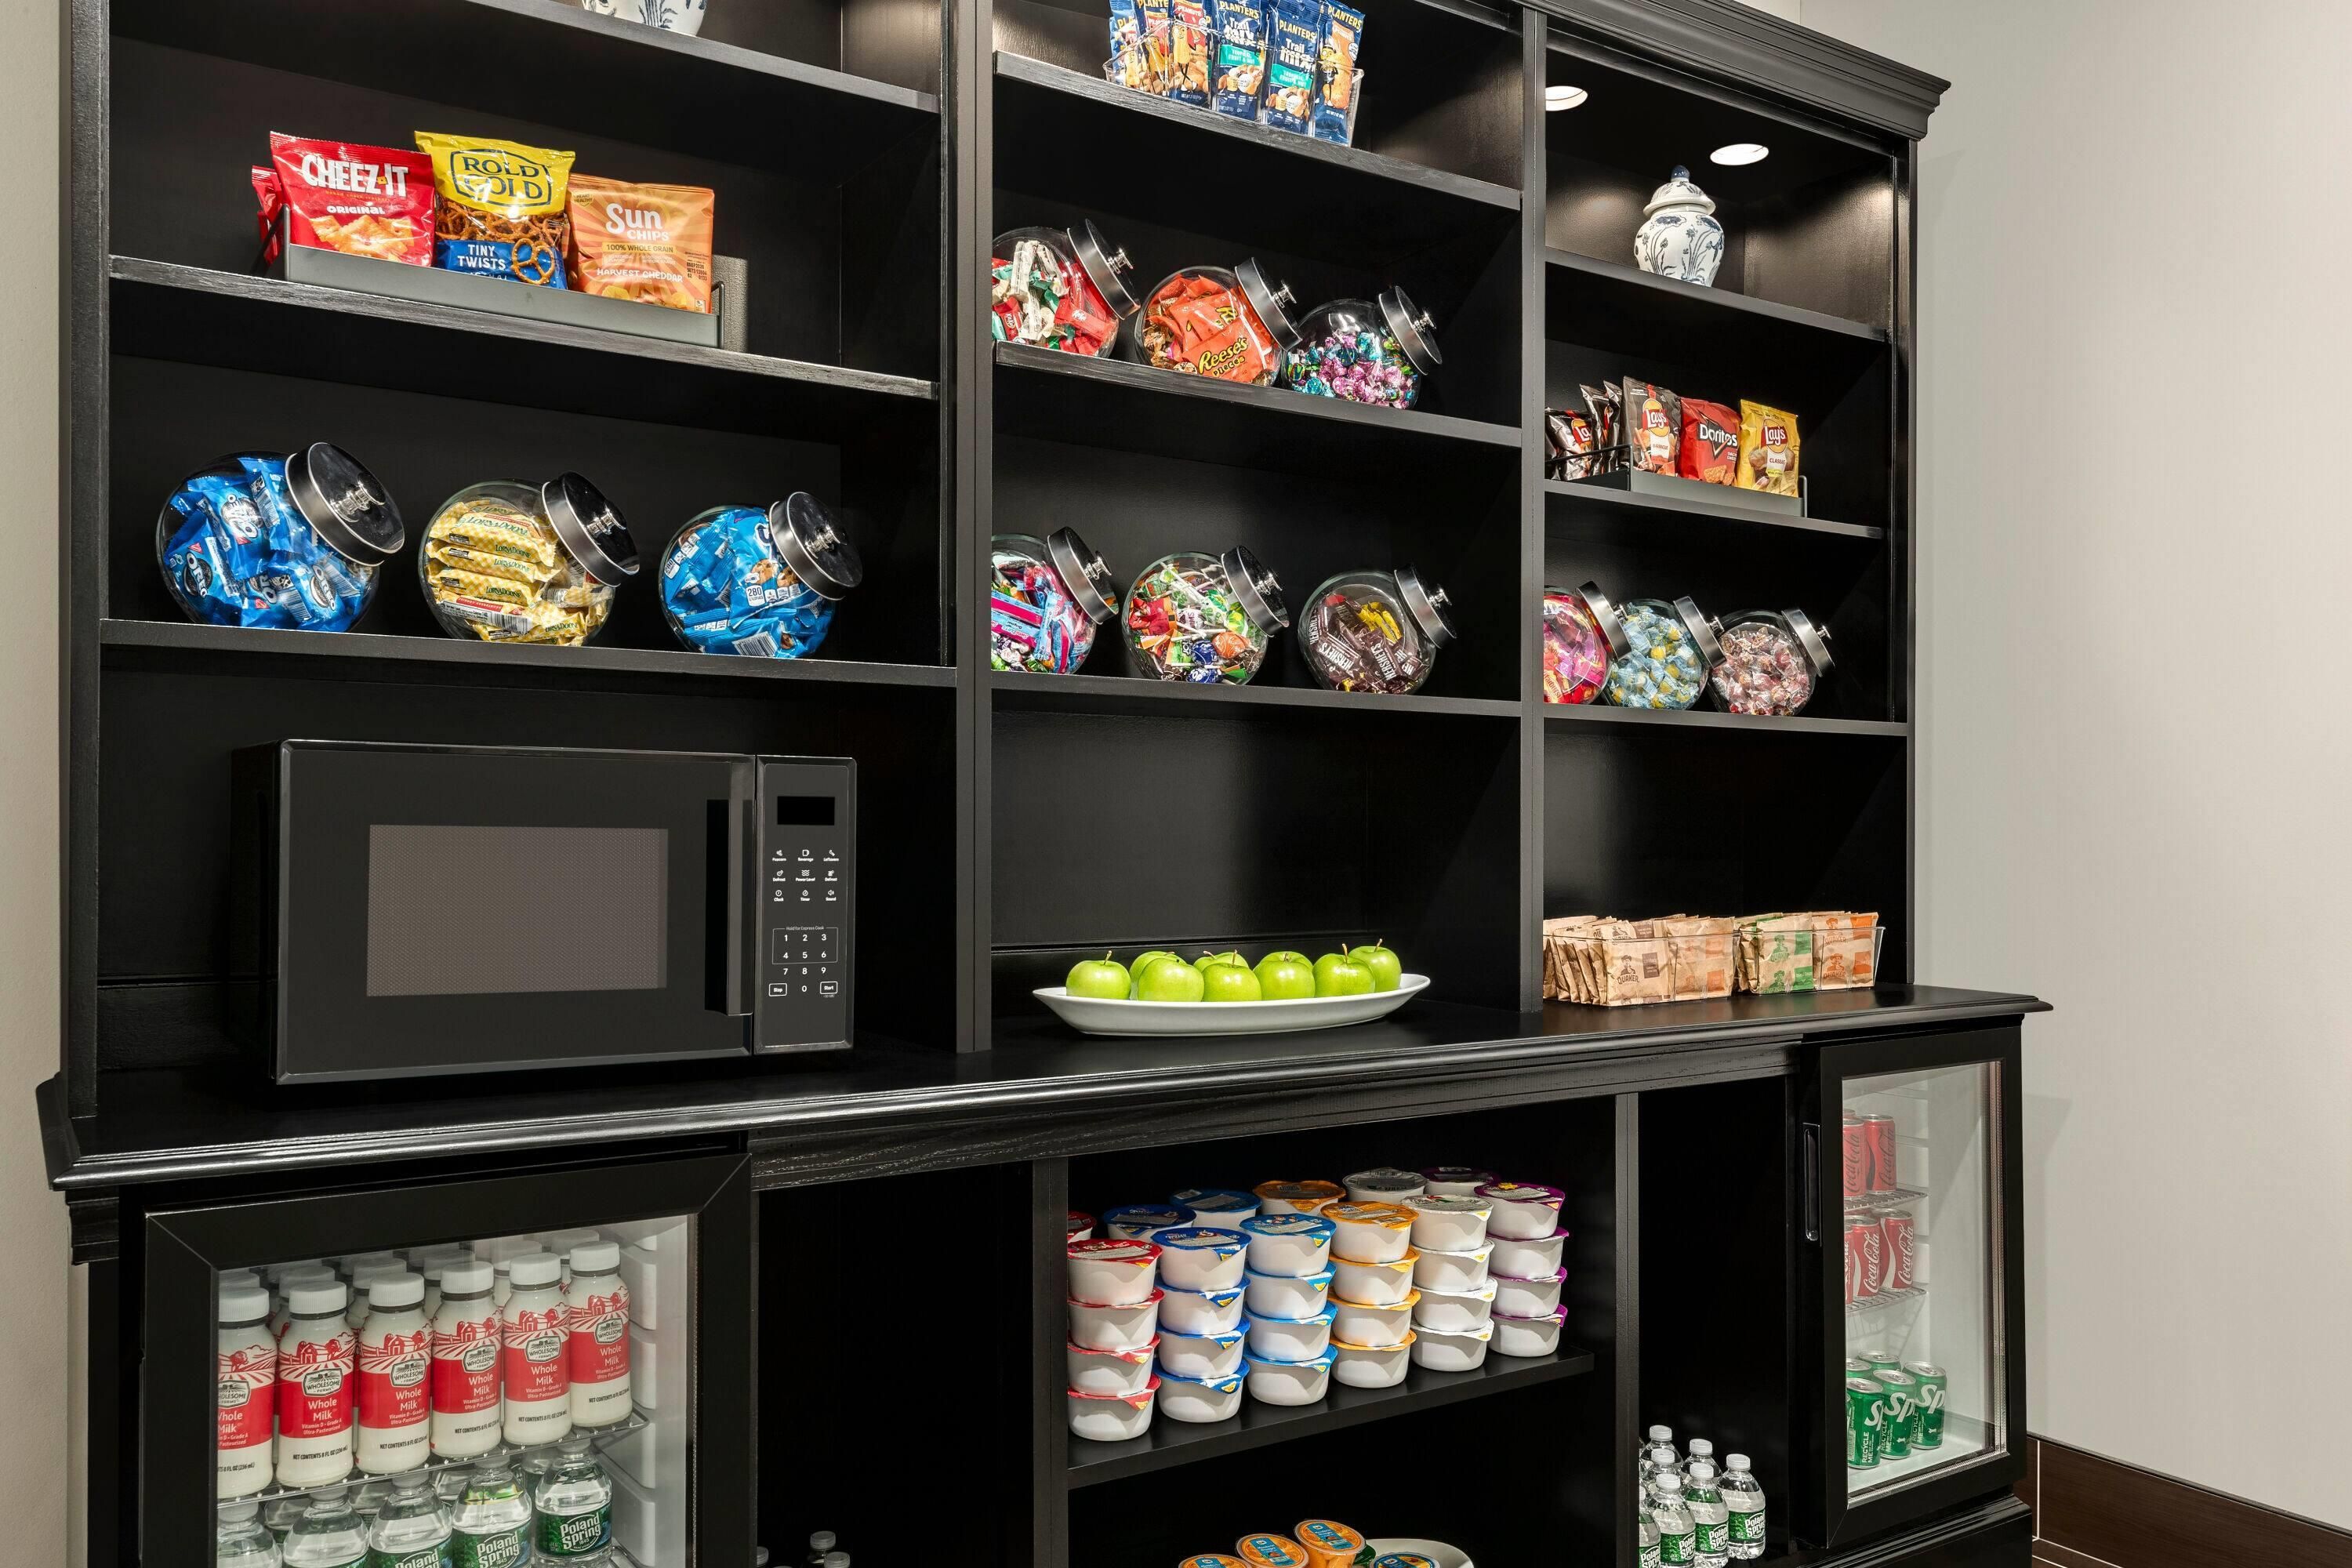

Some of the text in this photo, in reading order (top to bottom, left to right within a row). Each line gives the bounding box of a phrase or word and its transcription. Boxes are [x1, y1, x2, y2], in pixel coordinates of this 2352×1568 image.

[1220, 1, 1260, 20] PLANTERS
[1327, 6, 1362, 31] PLANTERS
[1279, 19, 1316, 42] PLANTERS
[1286, 38, 1305, 53] Trail
[462, 156, 539, 177] ROLD
[464, 173, 543, 199] GOLD
[605, 202, 663, 234] Sun
[627, 229, 670, 241] CHIPS
[467, 244, 496, 257] TINY
[457, 255, 506, 270] TWISTS
[597, 268, 684, 283] HARVEST CHEDDAR
[1198, 337, 1248, 375] Reese's
[1646, 408, 1668, 429] Lay's
[1699, 423, 1737, 447] Doritos
[1764, 426, 1787, 446] Lay's
[186, 552, 208, 597] OREO
[312, 564, 336, 611] OREO
[747, 586, 762, 596] 280
[1617, 974, 1639, 985] QUAKER
[1823, 971, 1846, 979] QUAKER
[529, 1347, 559, 1356] WHOLESOME
[600, 1345, 622, 1356] Whole
[466, 1356, 495, 1367] WHOLESOME
[604, 1356, 619, 1366] Milk
[394, 1370, 425, 1381] WHOLESOME
[531, 1363, 557, 1375] Whole
[307, 1380, 339, 1390] WHOLESOME
[468, 1373, 494, 1385] Whole
[536, 1375, 553, 1385] Milk
[396, 1388, 422, 1400] Whole
[474, 1386, 490, 1396] Milk
[308, 1399, 337, 1410] Whole
[400, 1400, 417, 1411] Milk
[313, 1410, 332, 1421] Milk
[1867, 1450, 1874, 1463] ME
[560, 1512, 601, 1537] Poland
[562, 1524, 602, 1550] Spring
[477, 1530, 518, 1558] Poland
[478, 1544, 520, 1568] Spring
